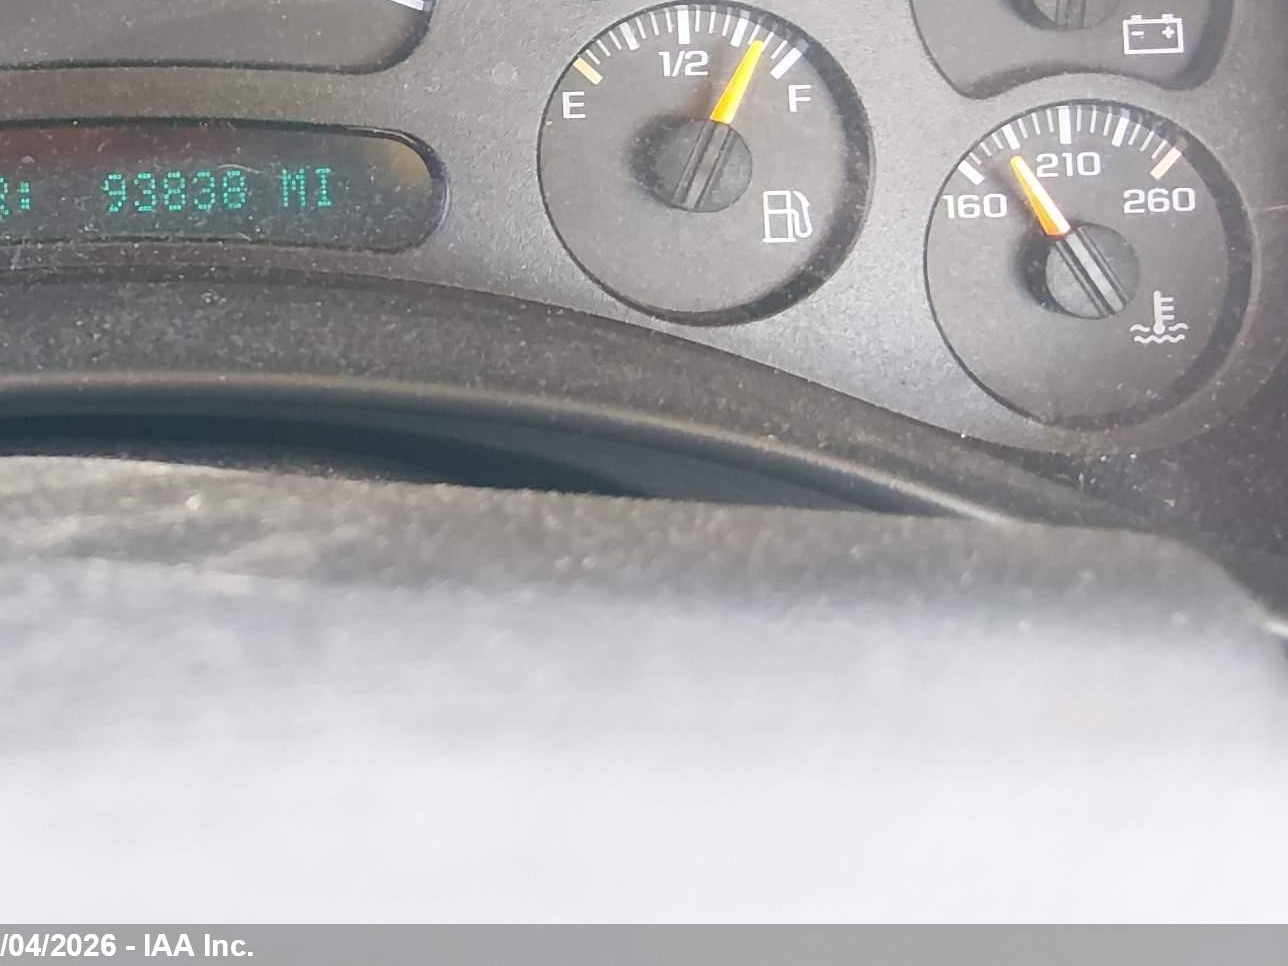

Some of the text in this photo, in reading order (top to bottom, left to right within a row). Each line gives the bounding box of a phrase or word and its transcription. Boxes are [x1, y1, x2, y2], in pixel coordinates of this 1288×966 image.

[658, 50, 709, 77] 1/2
[562, 91, 587, 119] E
[788, 84, 812, 113] F
[1033, 151, 1101, 179] 210
[103, 169, 247, 213] 93838
[282, 166, 332, 208] MI
[1123, 187, 1196, 214] 260
[942, 193, 1008, 219] 160
